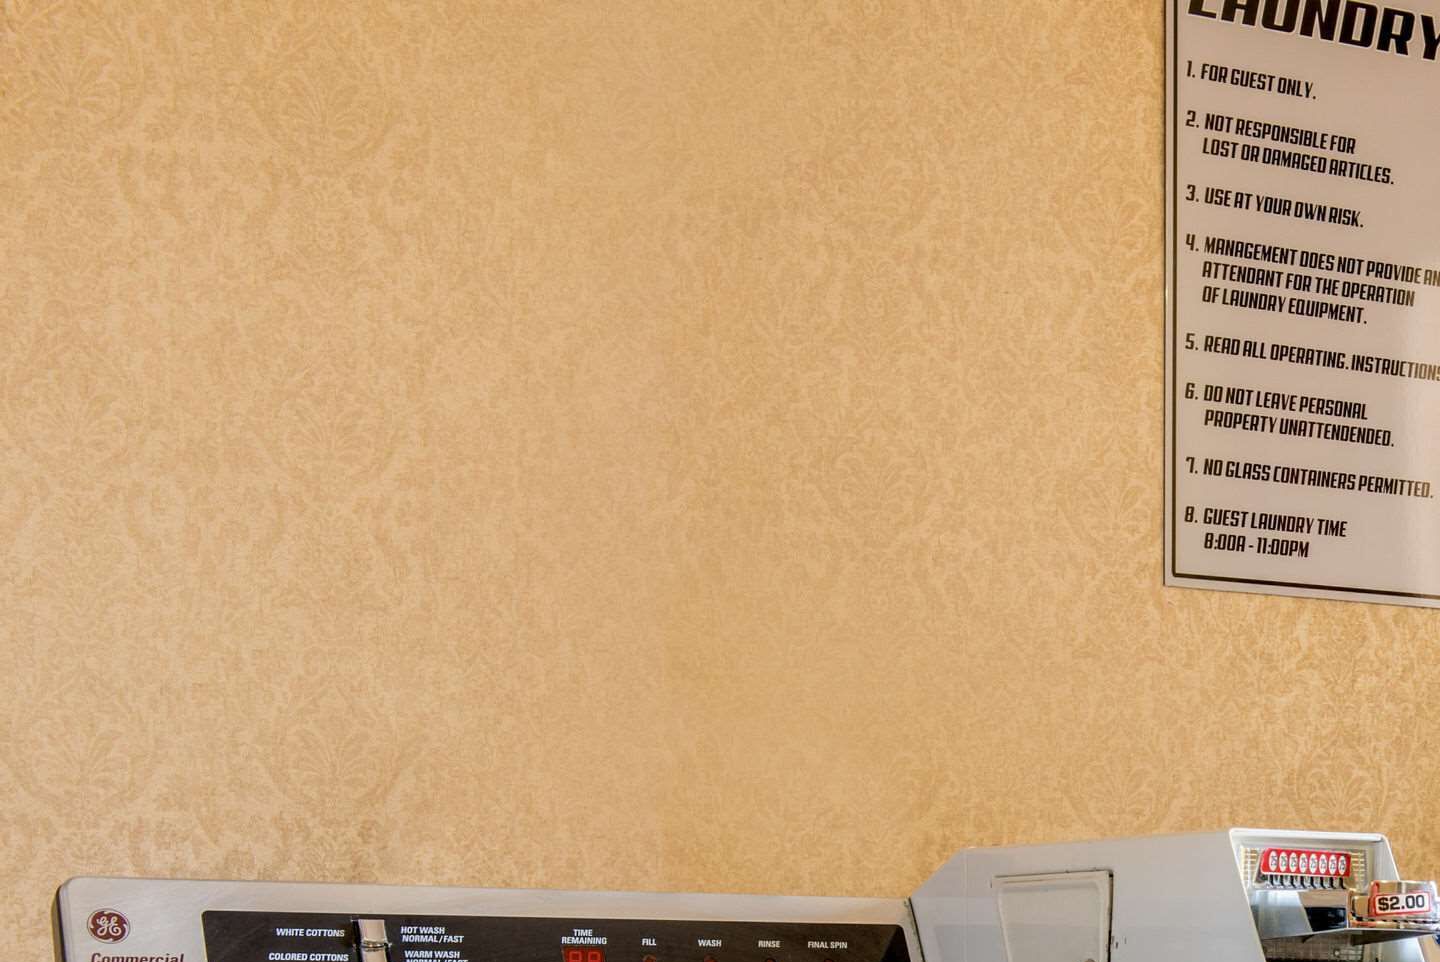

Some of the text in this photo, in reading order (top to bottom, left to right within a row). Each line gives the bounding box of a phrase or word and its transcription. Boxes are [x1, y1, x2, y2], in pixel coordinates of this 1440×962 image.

[1187, 61, 1316, 99] 1. FOR GUEST ONLY.
[1186, 110, 1356, 154] 2. NOT RESPONSIBLE FOR
[1203, 137, 1394, 184] LOST OR DAMAGED ARTICLES.
[1186, 184, 1363, 227] 3. USE AT YOUR OWN RISK.
[1186, 234, 1199, 251] 4.
[1204, 236, 1298, 266] MANAGEMENT
[1300, 251, 1334, 271] DOES
[1337, 257, 1365, 275] NOT
[1366, 260, 1422, 284] PROVIDE
[1202, 261, 1415, 306] ATTENDANT FOR THE OPERATION
[1202, 286, 1367, 324] OF LAUNDRY EQUIPMENT.
[1186, 333, 1198, 350] 5.
[1204, 336, 1240, 355] READ
[1243, 341, 1267, 359] ALL
[1270, 344, 1349, 370] OPERATING.
[1185, 382, 1368, 420] 6. DO NOT LEAVE PERSONAL
[1204, 410, 1394, 447] PROPERTY UNATTENDENDED.
[1186, 457, 1433, 499] 7. NO GLASS CONTAINERS PERMITTED.
[1185, 506, 1347, 537] 8. GUEST LAUNDRY TIME
[1204, 533, 1246, 552] 8:00A
[1257, 537, 1309, 557] 11:00PM
[1378, 895, 1425, 911] $2.00
[276, 928, 345, 937] WHITE COTTONS
[402, 935, 464, 943] NORMAL/FAST
[562, 937, 607, 945] REMAINING
[642, 938, 656, 946] FILL
[758, 940, 781, 948] RINSE
[808, 941, 847, 949] FINAL SPIN
